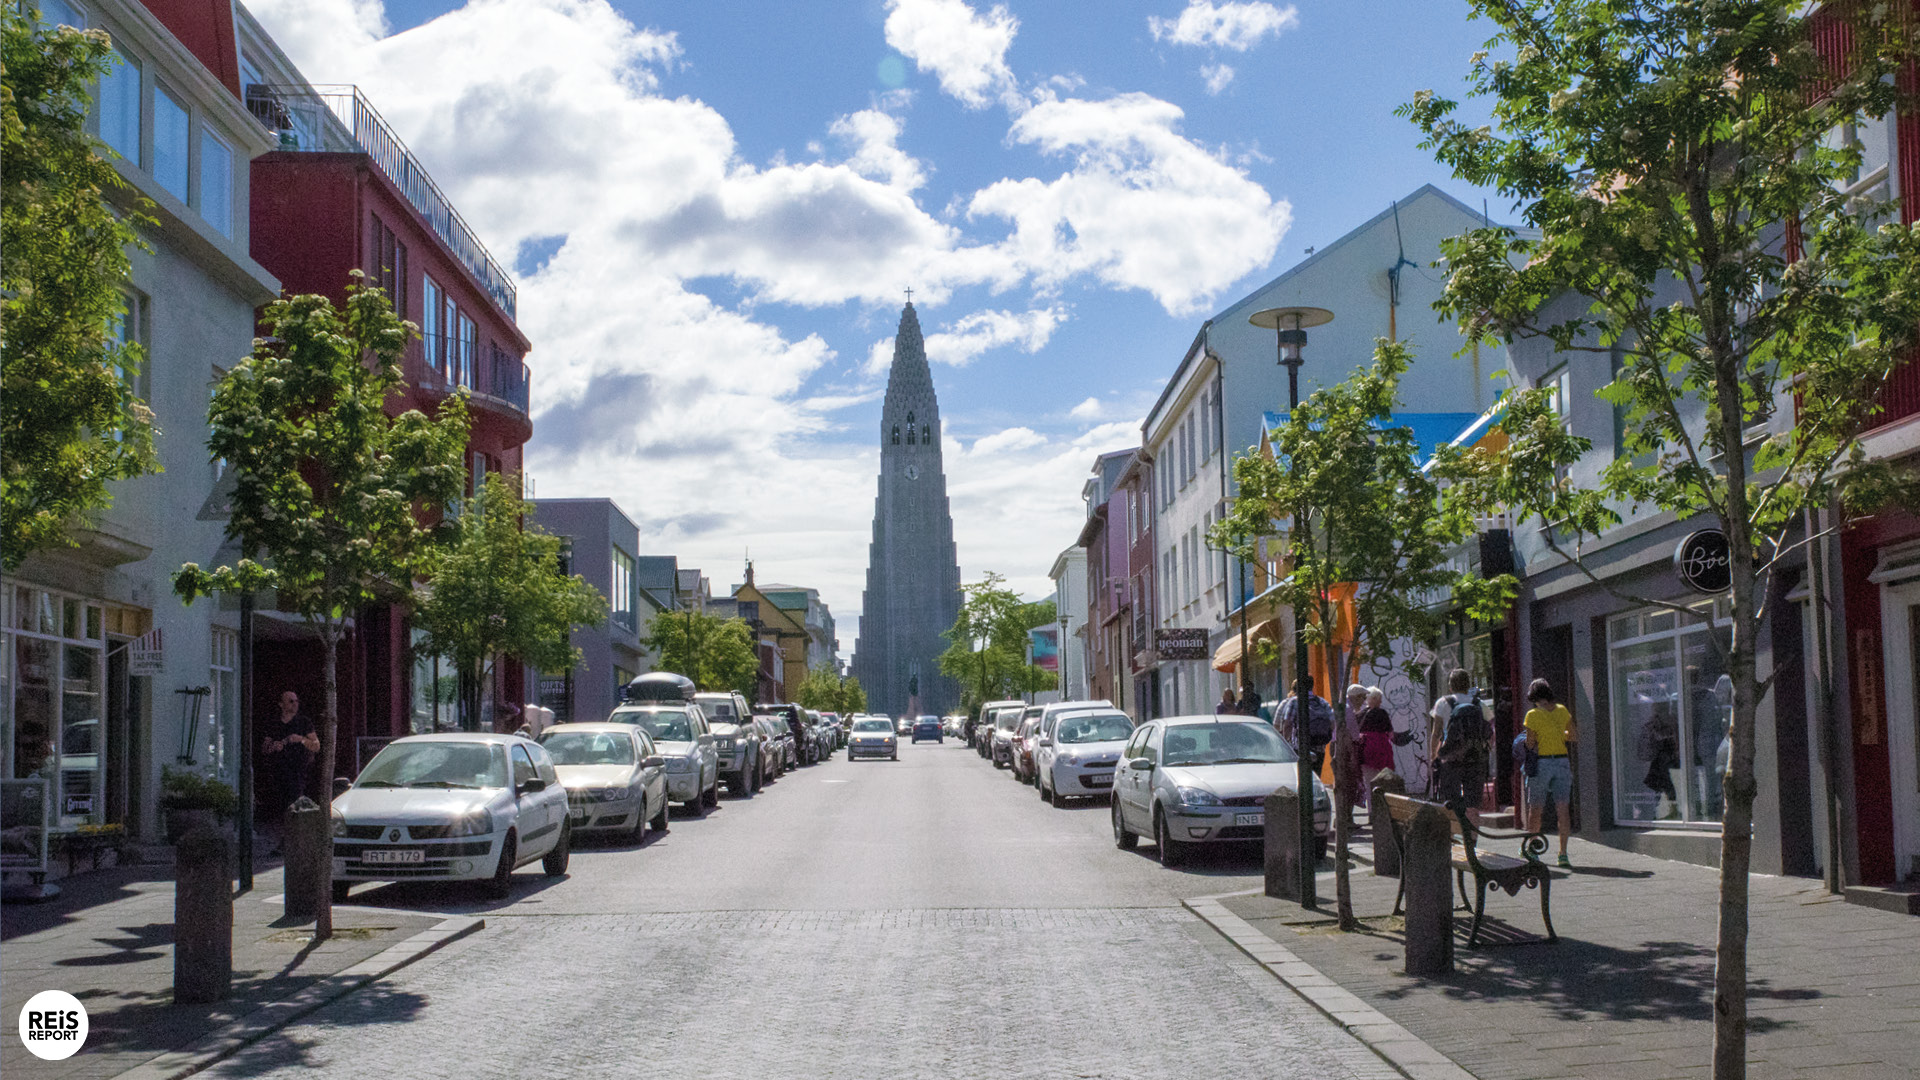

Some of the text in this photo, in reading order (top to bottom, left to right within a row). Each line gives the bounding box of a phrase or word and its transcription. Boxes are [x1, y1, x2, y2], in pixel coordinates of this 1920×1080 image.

[1683, 546, 1730, 578] Bóe
[1159, 639, 1204, 650] yeoman
[370, 851, 420, 862] RT 179
